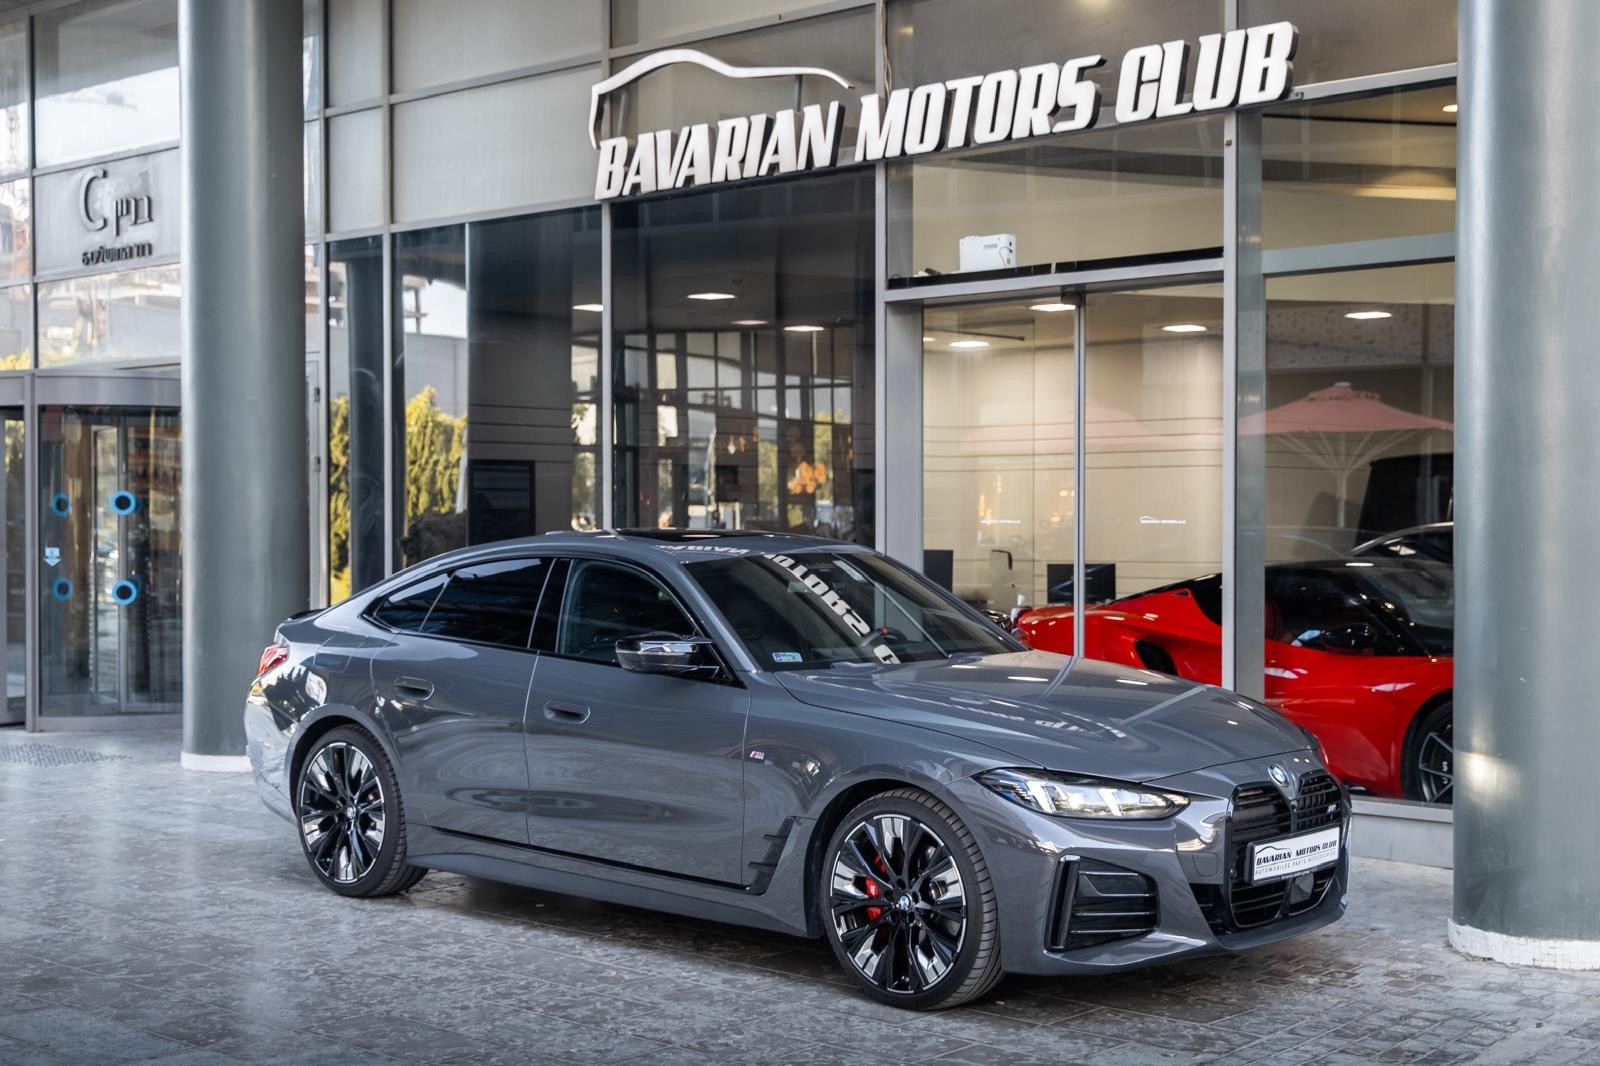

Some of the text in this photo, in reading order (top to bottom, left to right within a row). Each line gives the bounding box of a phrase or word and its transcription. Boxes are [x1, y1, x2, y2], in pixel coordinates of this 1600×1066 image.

[594, 21, 1296, 201] BAVARIAN MOTORS CLUB
[1256, 852, 1291, 866] BAVARIAN
[1295, 844, 1320, 856] MOTORS
